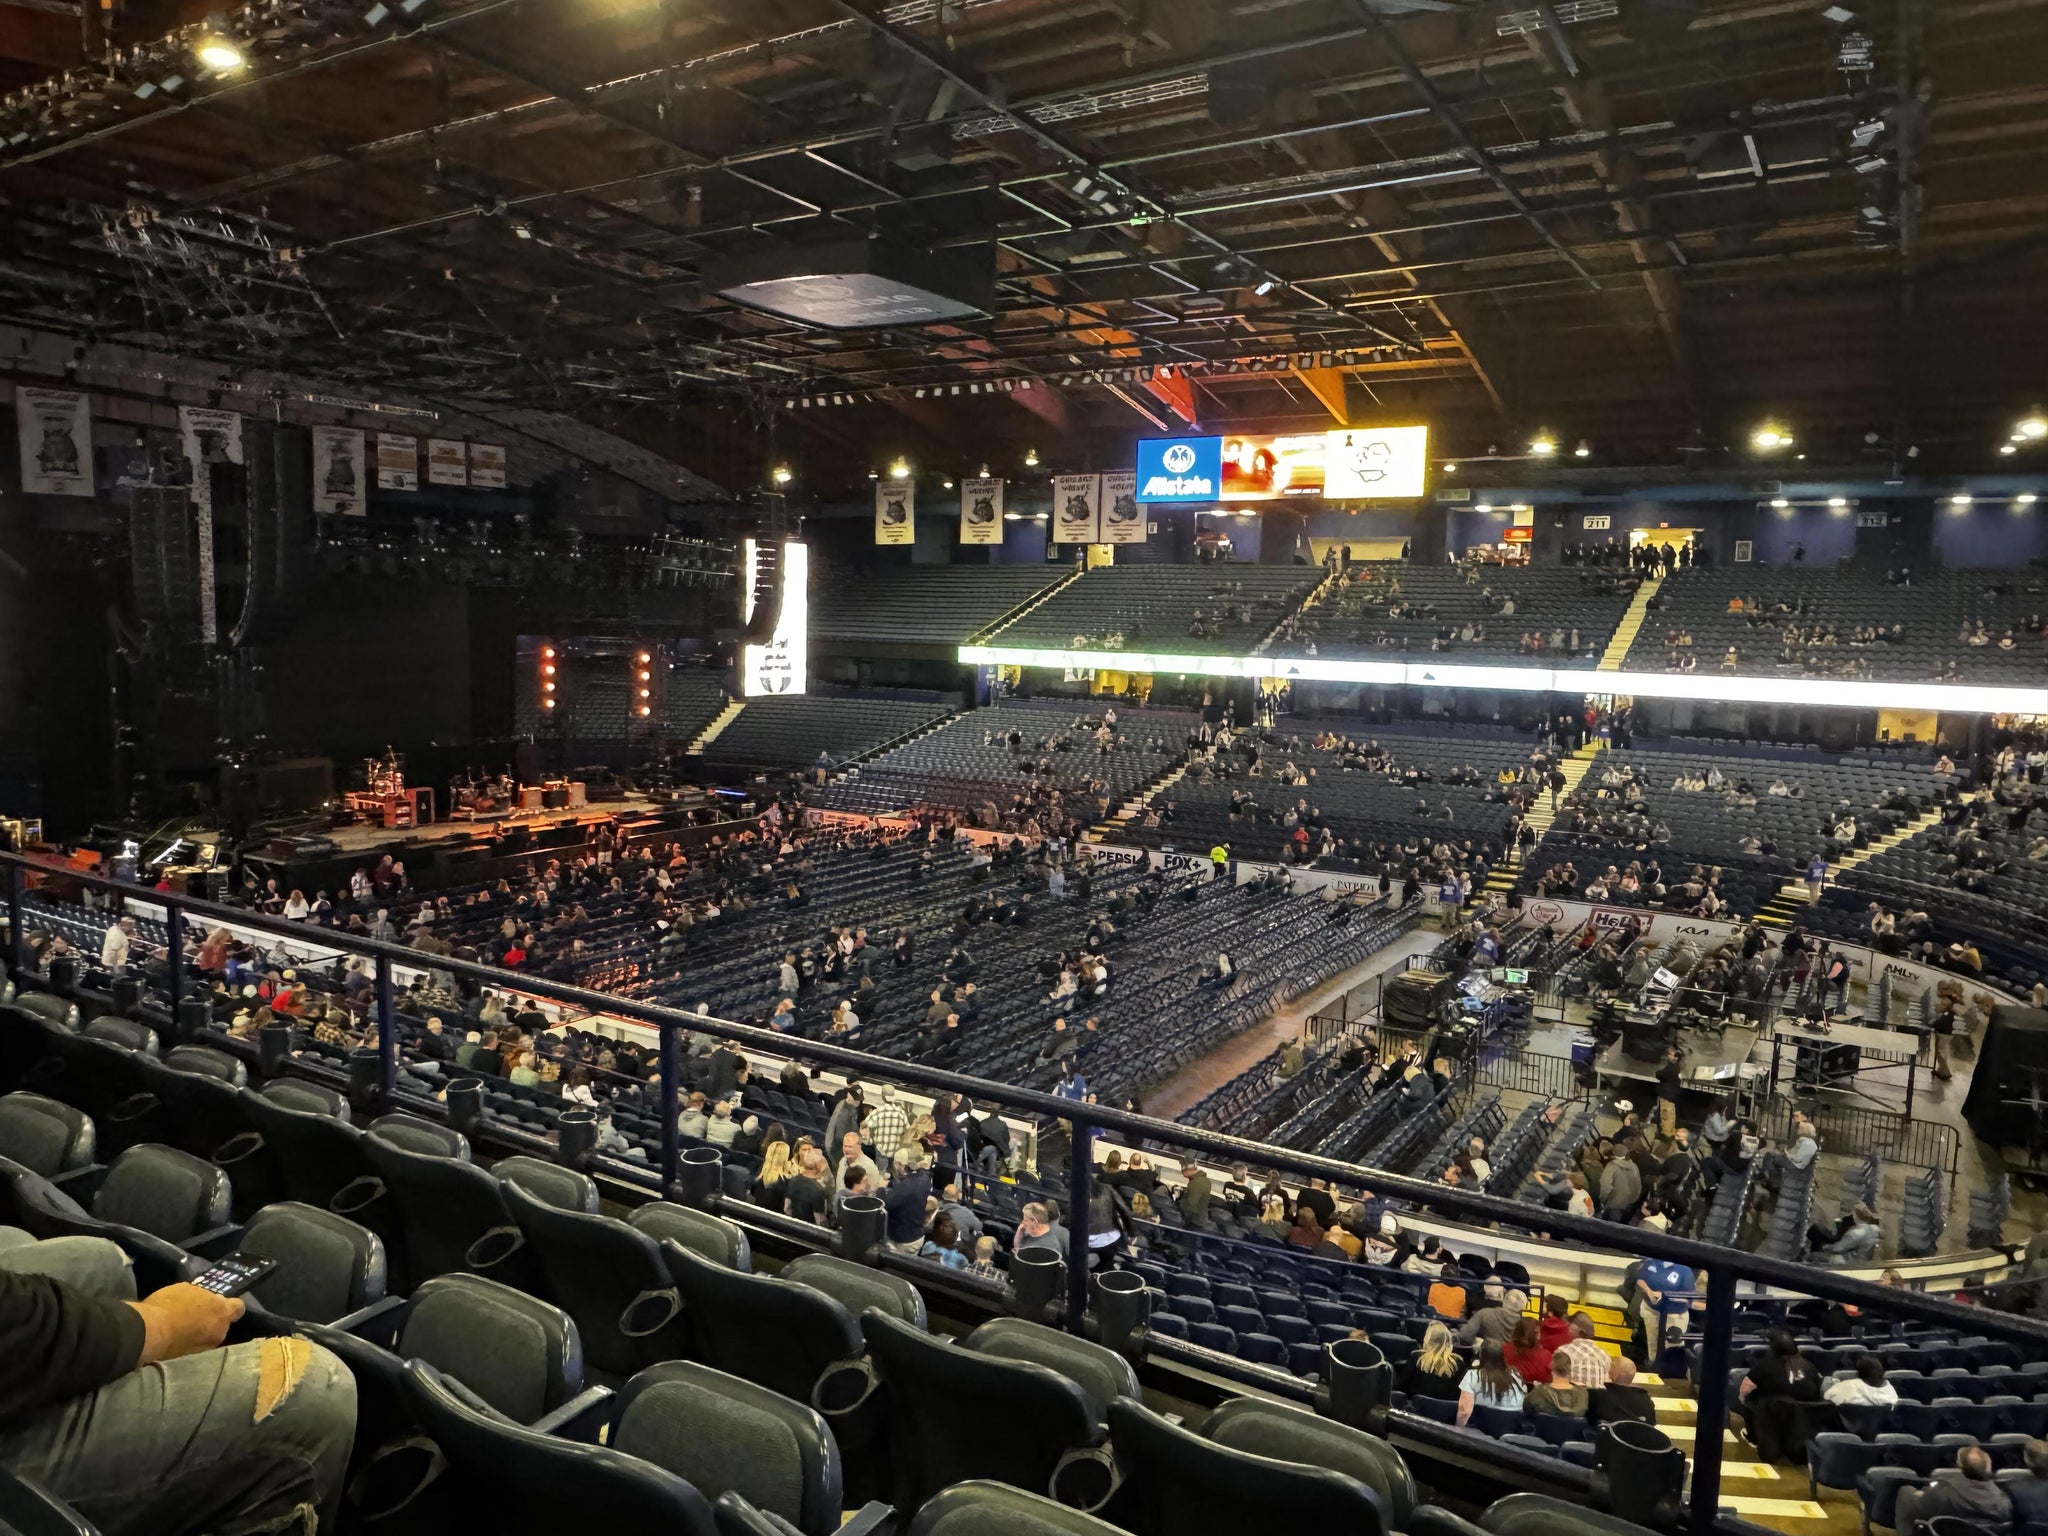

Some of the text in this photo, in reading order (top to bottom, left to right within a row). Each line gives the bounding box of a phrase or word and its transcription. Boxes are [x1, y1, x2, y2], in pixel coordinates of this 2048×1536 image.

[1141, 475, 1212, 497] Allstate
[1586, 520, 1607, 529] 211
[1098, 850, 1137, 865] PEPSI
